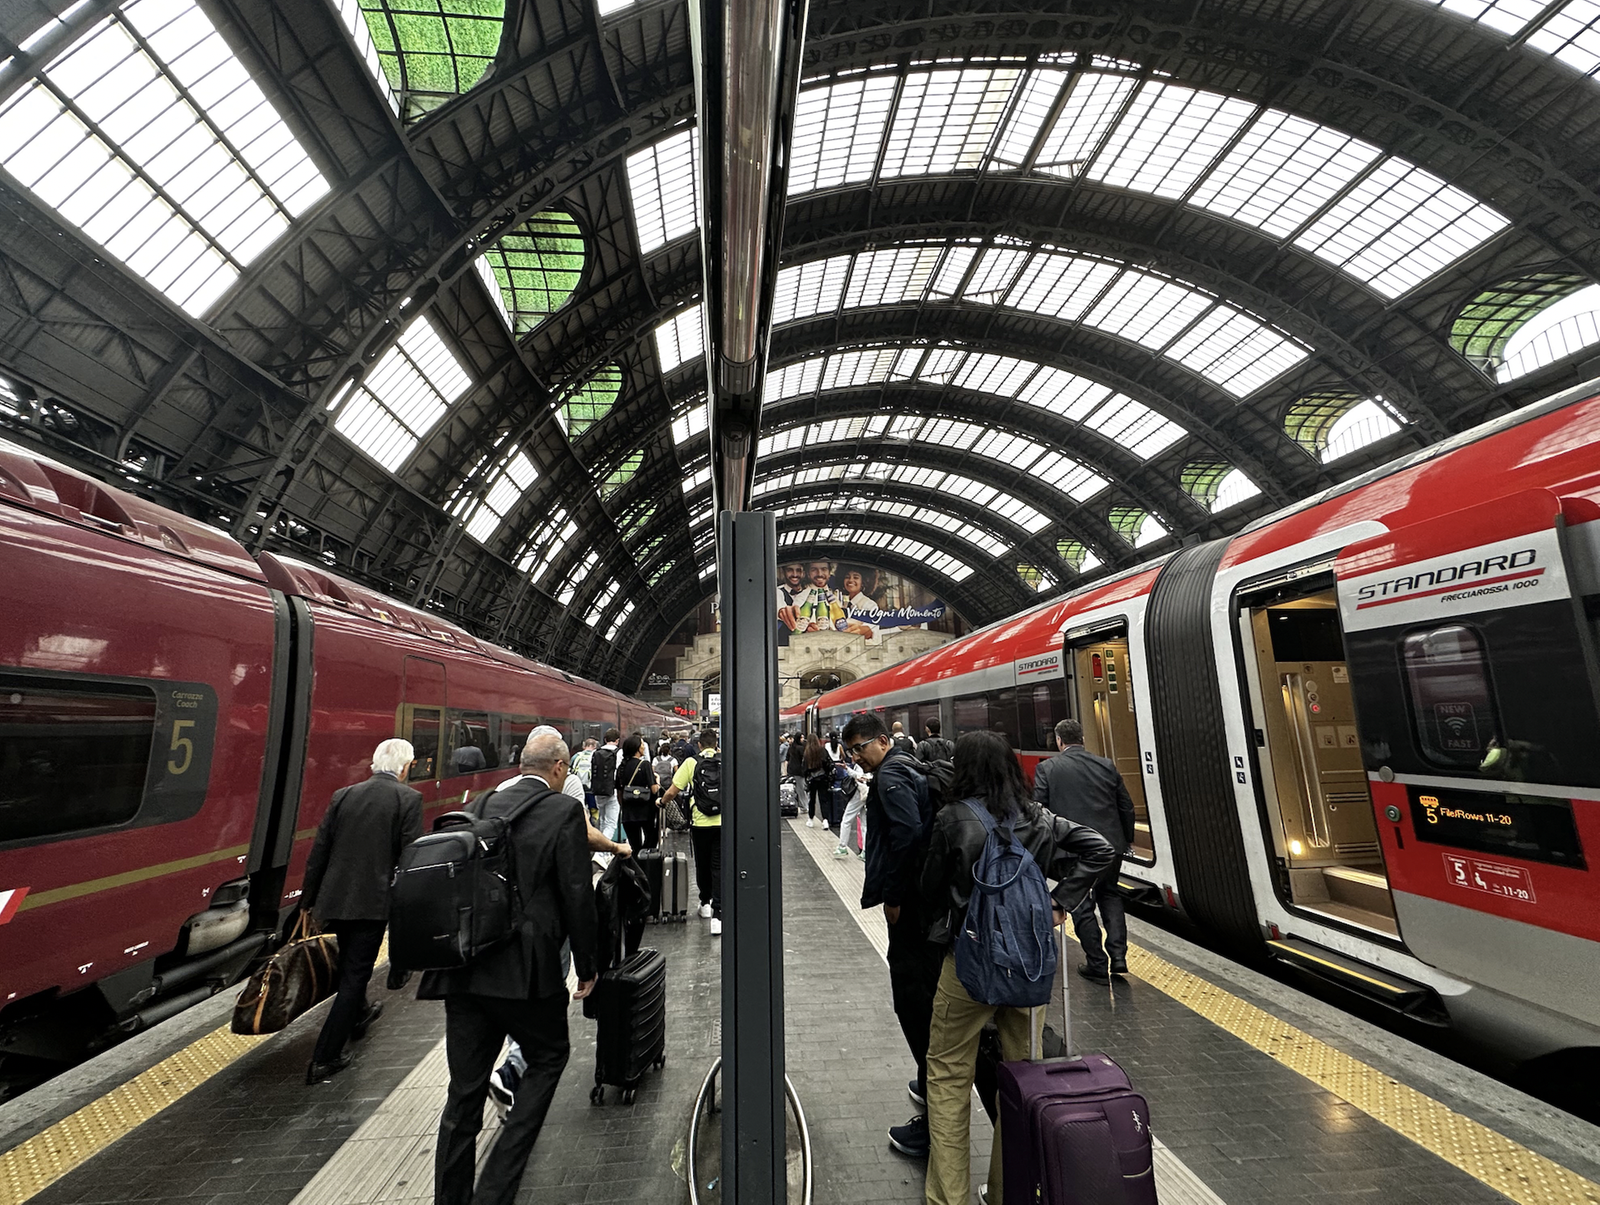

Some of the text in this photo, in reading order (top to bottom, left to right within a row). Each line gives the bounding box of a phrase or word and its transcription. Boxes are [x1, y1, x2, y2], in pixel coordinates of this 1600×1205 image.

[1357, 549, 1537, 601] STANDARD
[1440, 579, 1539, 603] FRECCIAROSSA 1000
[846, 604, 943, 624] Vivi Ogni Momento
[1018, 656, 1058, 671] STANDARD
[176, 699, 198, 708] Coach
[1440, 705, 1466, 714] NEW
[167, 719, 195, 775] 5
[1447, 739, 1472, 748] FAST
[1426, 807, 1438, 824] 5
[1485, 813, 1512, 825] 11-20
[1454, 862, 1466, 881] 5
[1502, 885, 1529, 899] 11-20
